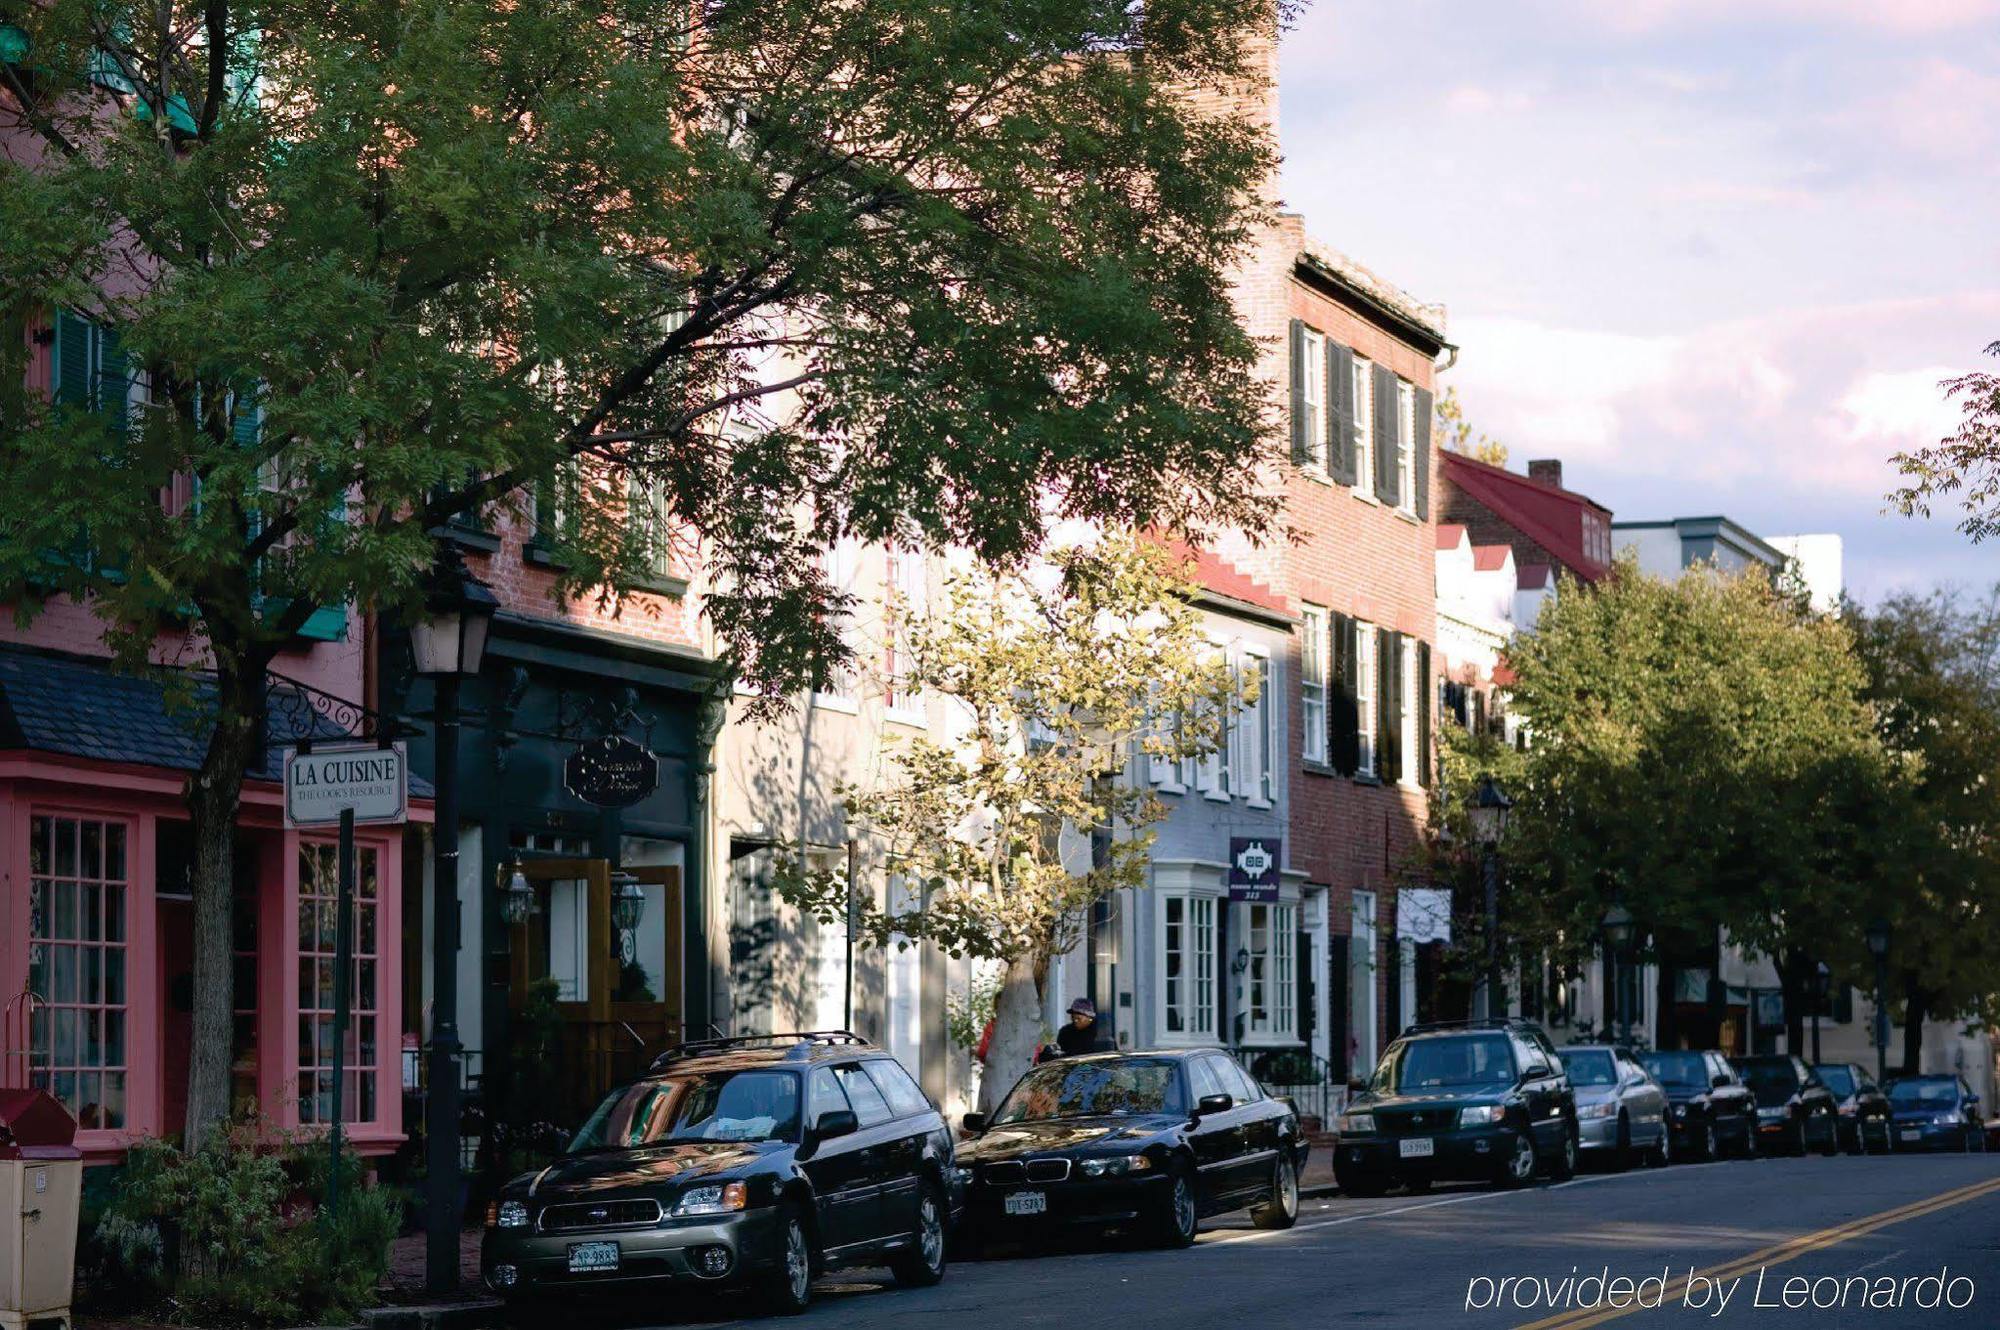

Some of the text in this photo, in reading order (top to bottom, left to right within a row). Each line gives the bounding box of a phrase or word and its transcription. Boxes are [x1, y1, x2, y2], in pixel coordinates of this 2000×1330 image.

[294, 758, 396, 786] LA CUISINE
[299, 791, 316, 801] THE
[349, 785, 392, 798] RESOURCE
